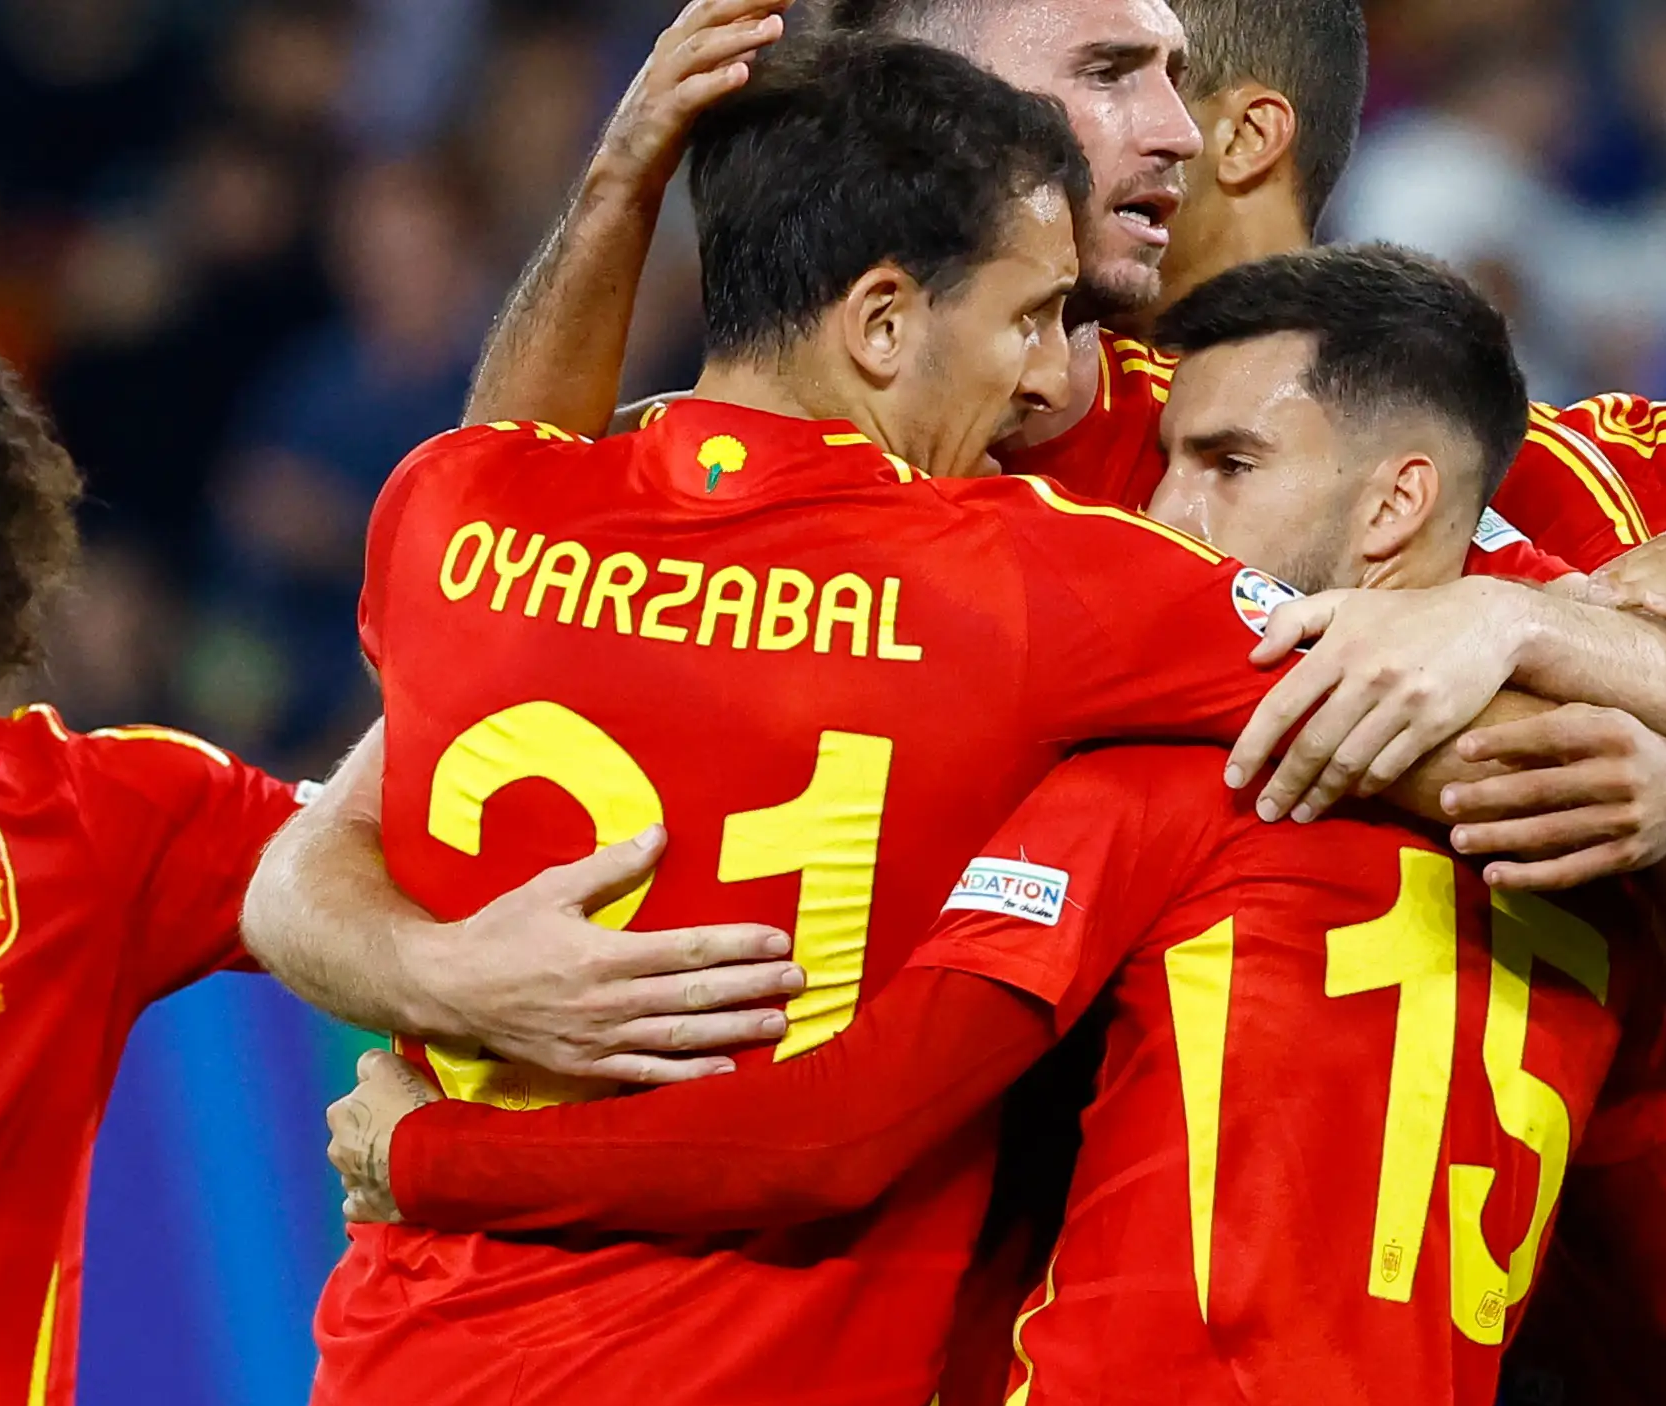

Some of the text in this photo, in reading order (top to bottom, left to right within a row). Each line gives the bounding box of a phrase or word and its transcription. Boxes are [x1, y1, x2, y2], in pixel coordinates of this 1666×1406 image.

[438, 519, 923, 662] OYARZABAL
[424, 700, 894, 1111] 21
[1002, 899, 1054, 919] for children
[1324, 846, 1610, 1346] 15
